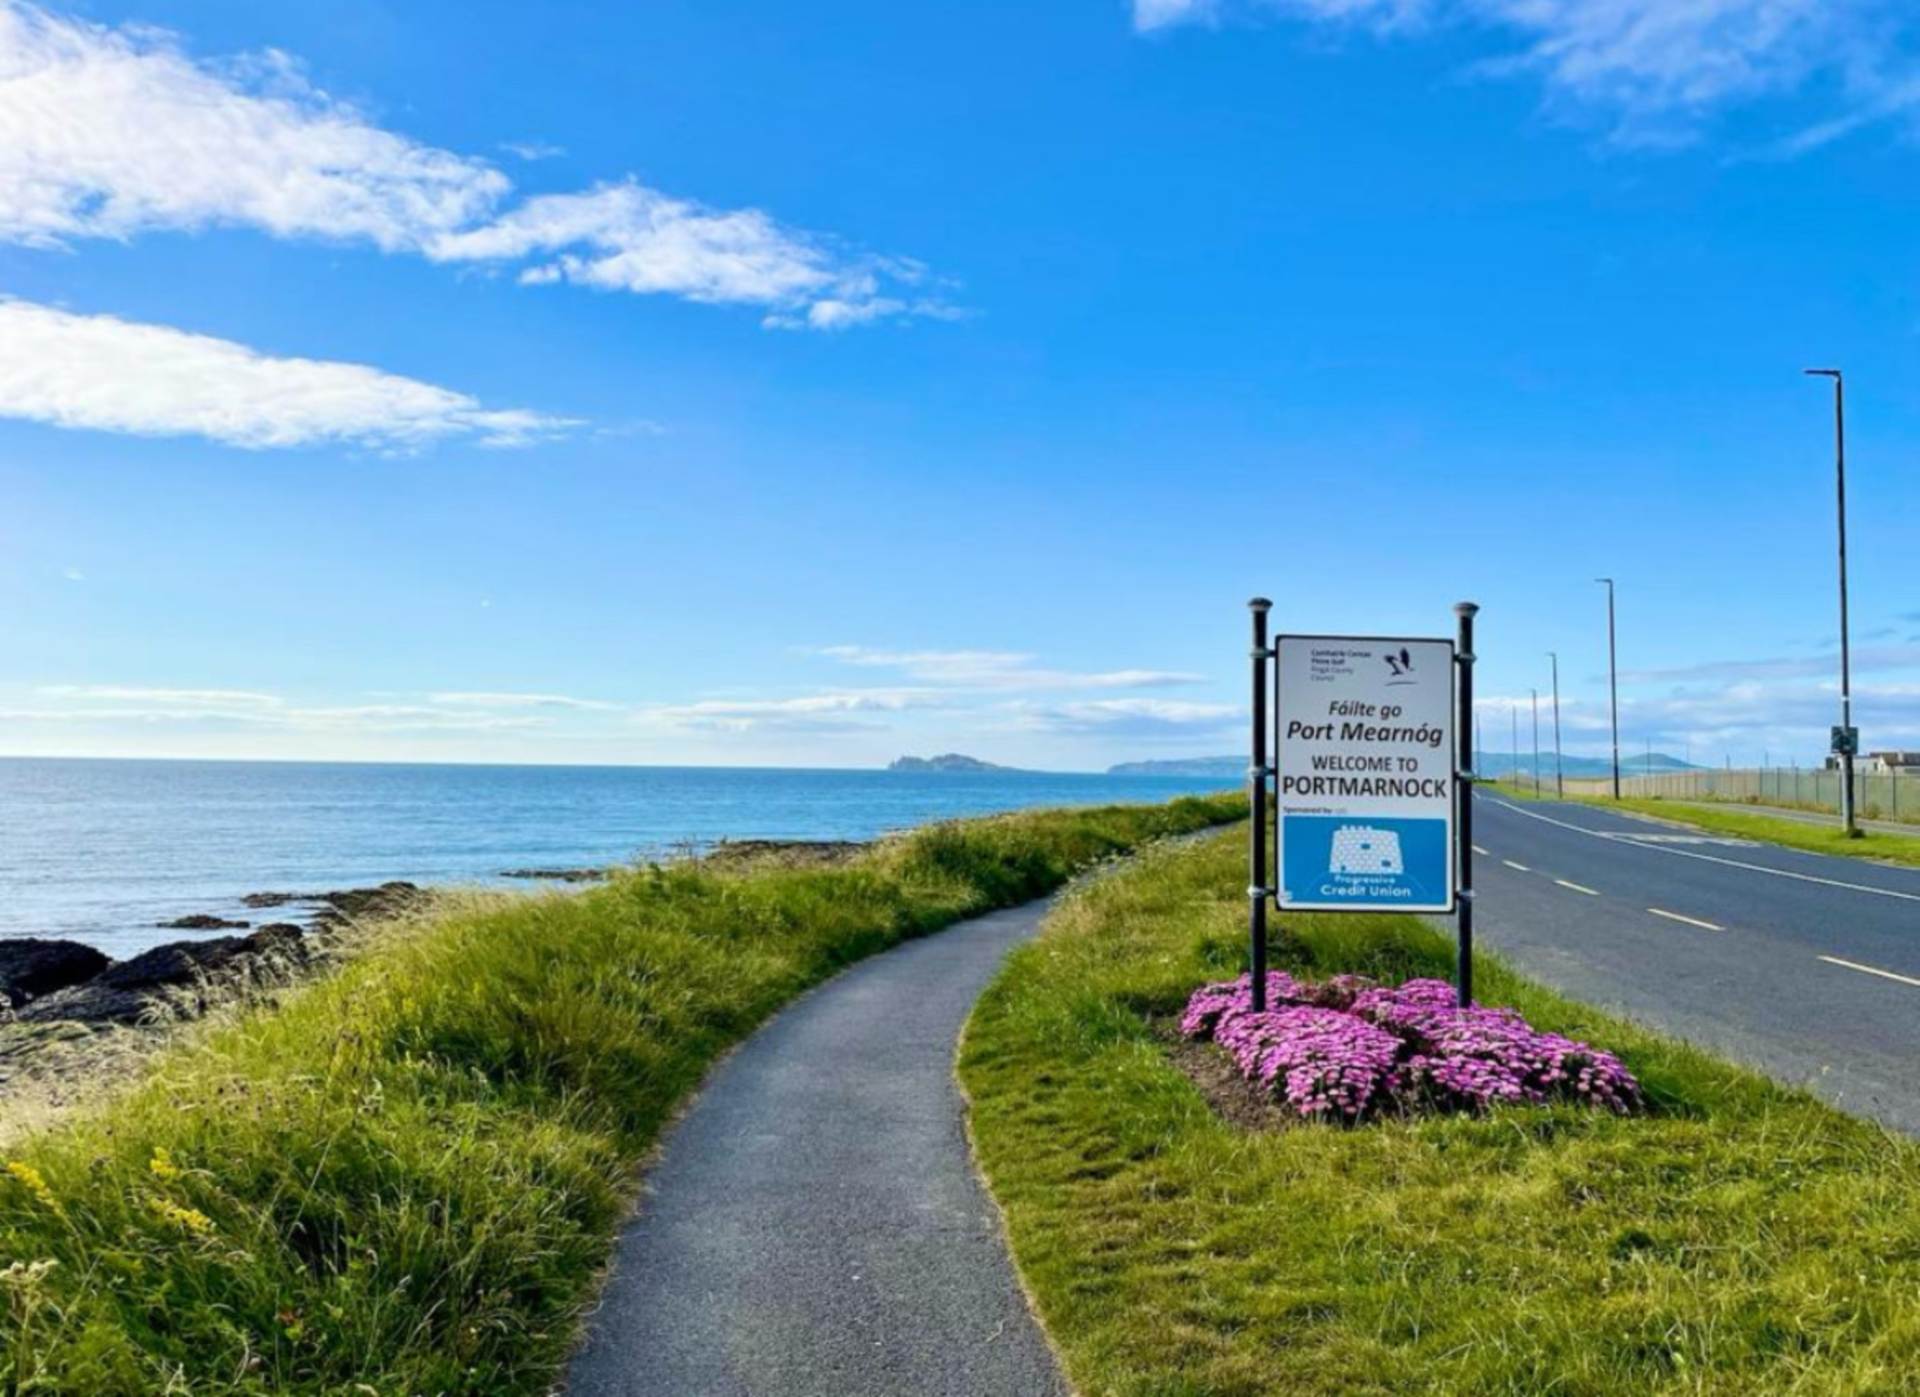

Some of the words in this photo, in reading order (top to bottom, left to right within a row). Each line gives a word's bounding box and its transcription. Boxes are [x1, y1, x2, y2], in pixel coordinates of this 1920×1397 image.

[1328, 700, 1376, 718] Fáilte
[1380, 705, 1403, 720] go
[1287, 721, 1334, 741] Port
[1340, 722, 1443, 747] Mearnóg
[1312, 755, 1393, 772] WELCOME
[1397, 757, 1418, 773] TO
[1282, 776, 1447, 798] PORTMARNOCK
[1334, 875, 1396, 885] Progressive
[1320, 884, 1366, 896] Credit
[1369, 886, 1411, 897] Union
